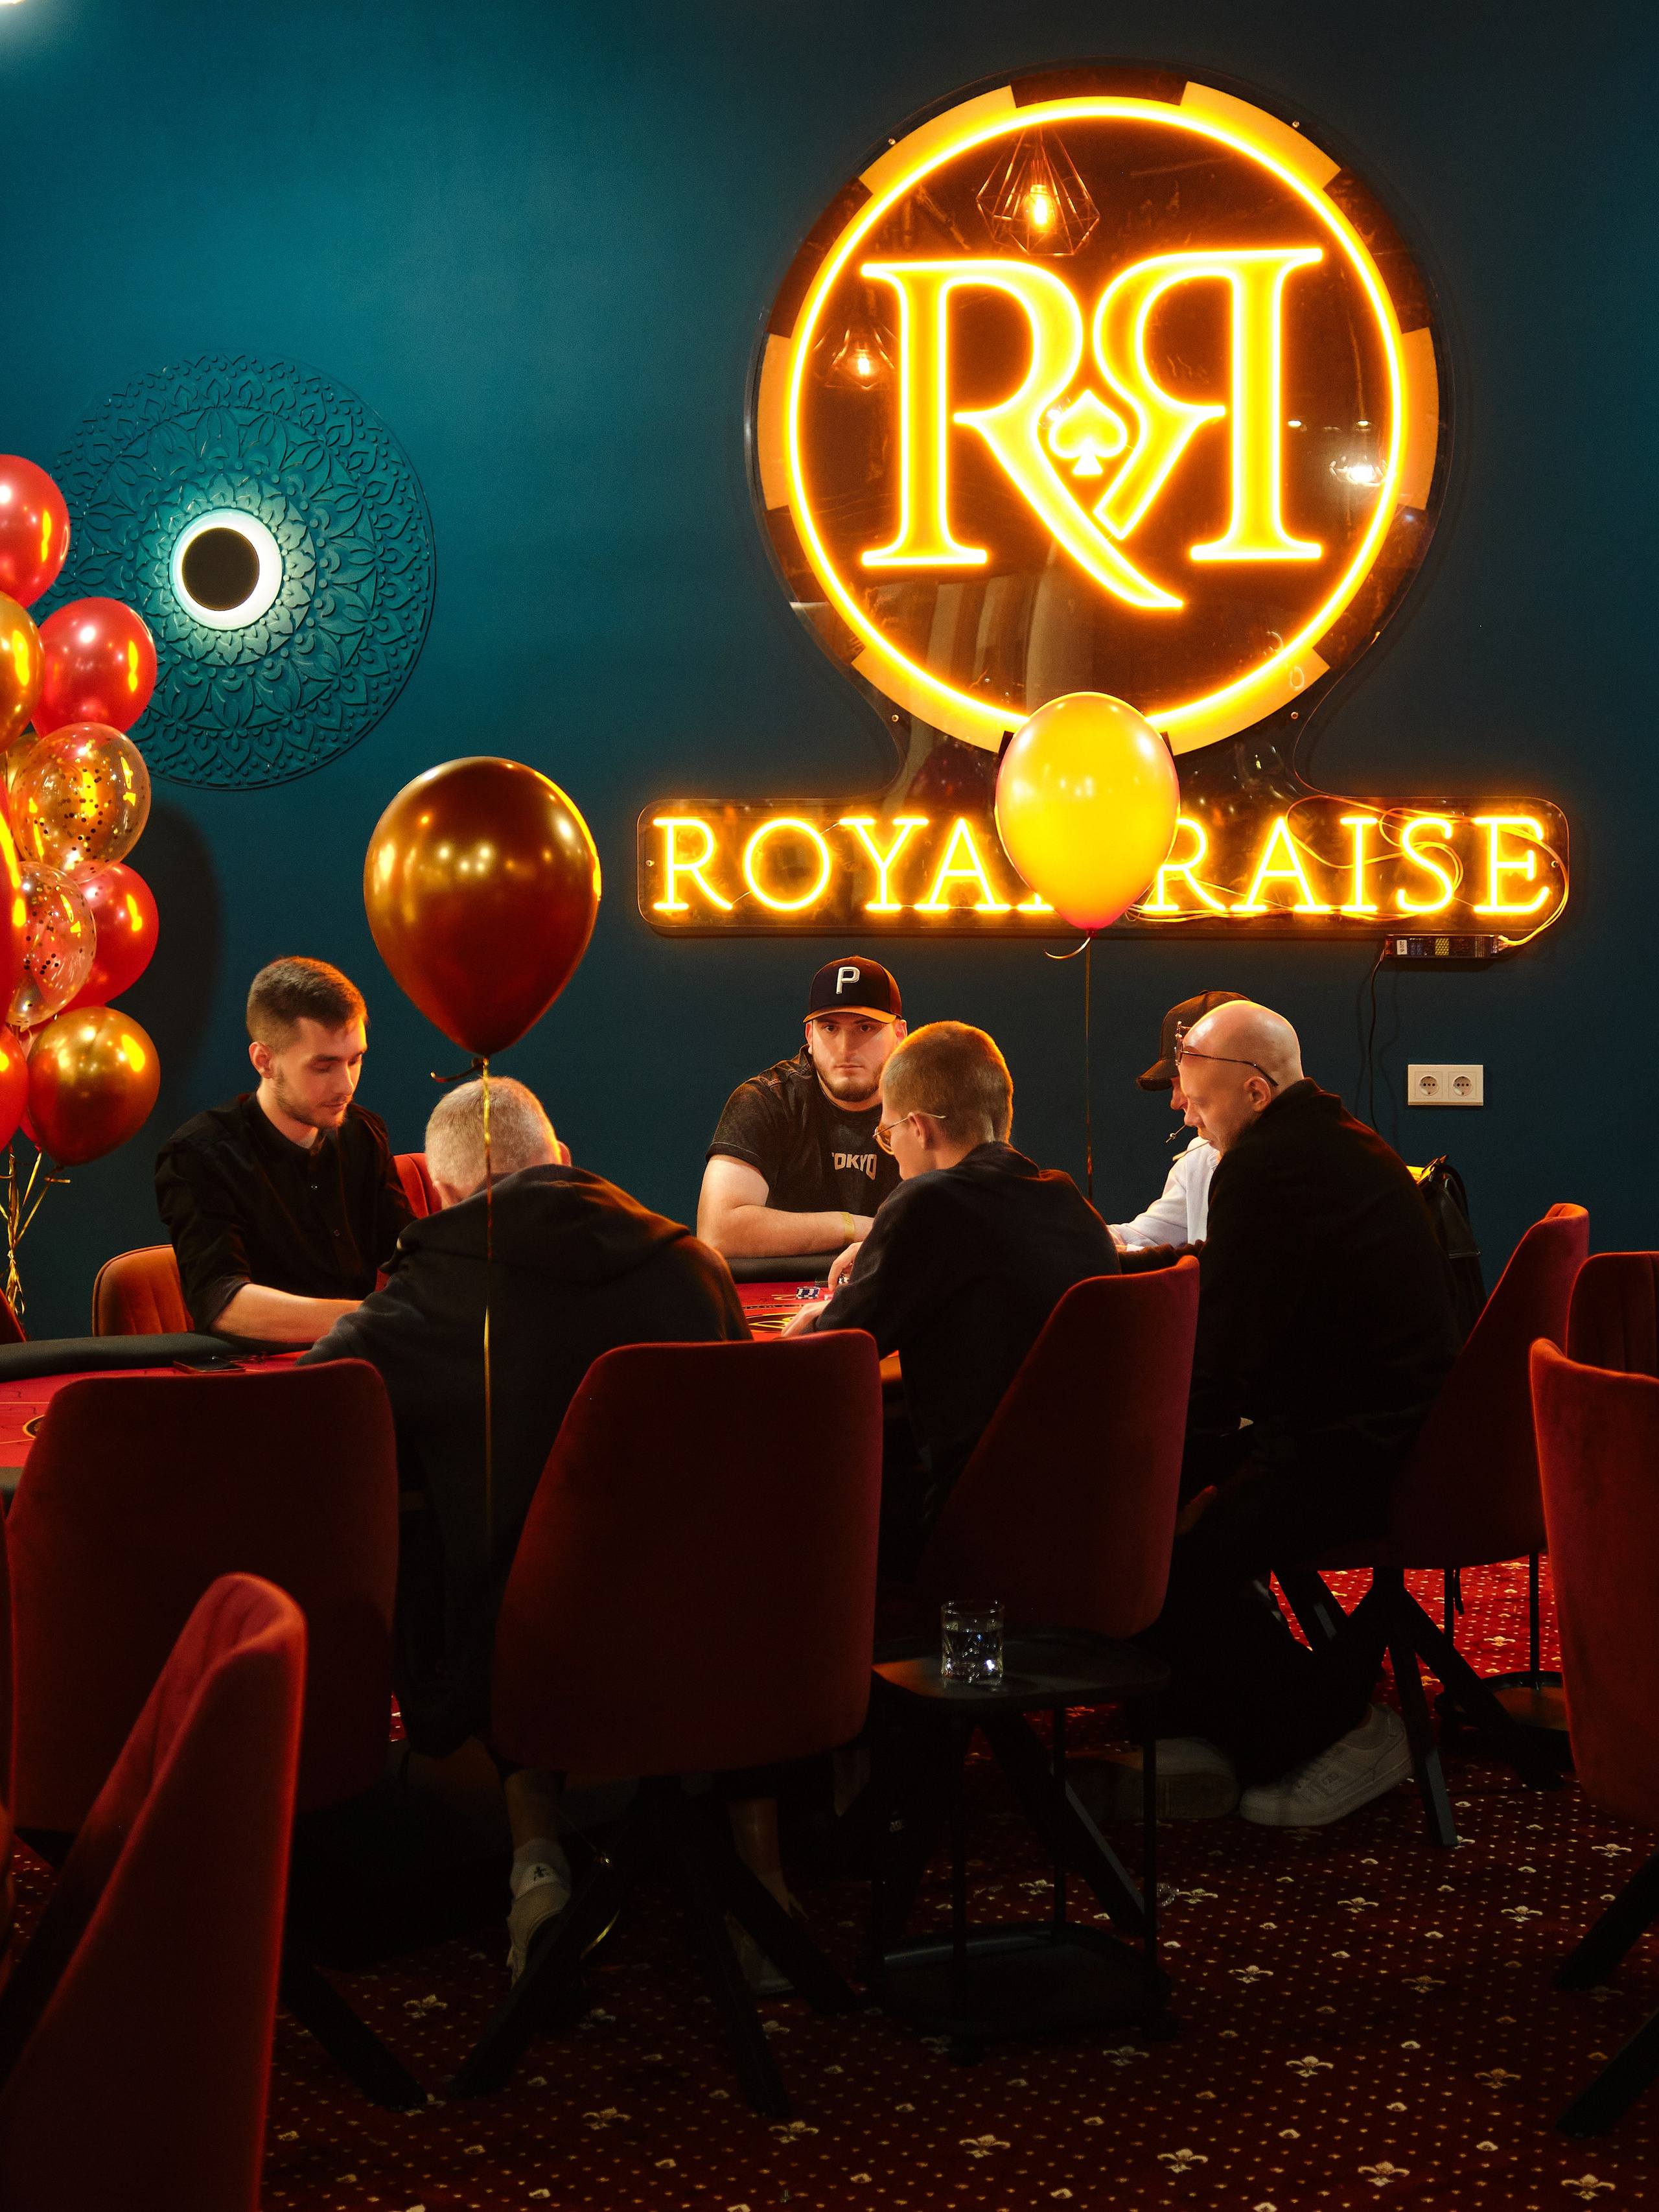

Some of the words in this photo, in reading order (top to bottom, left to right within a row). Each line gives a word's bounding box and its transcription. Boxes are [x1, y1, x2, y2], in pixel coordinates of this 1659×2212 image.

[653, 817, 1055, 911] ROYA
[1143, 817, 1549, 913] RAISE
[835, 966, 861, 994] P
[831, 1152, 877, 1181] OKYO
